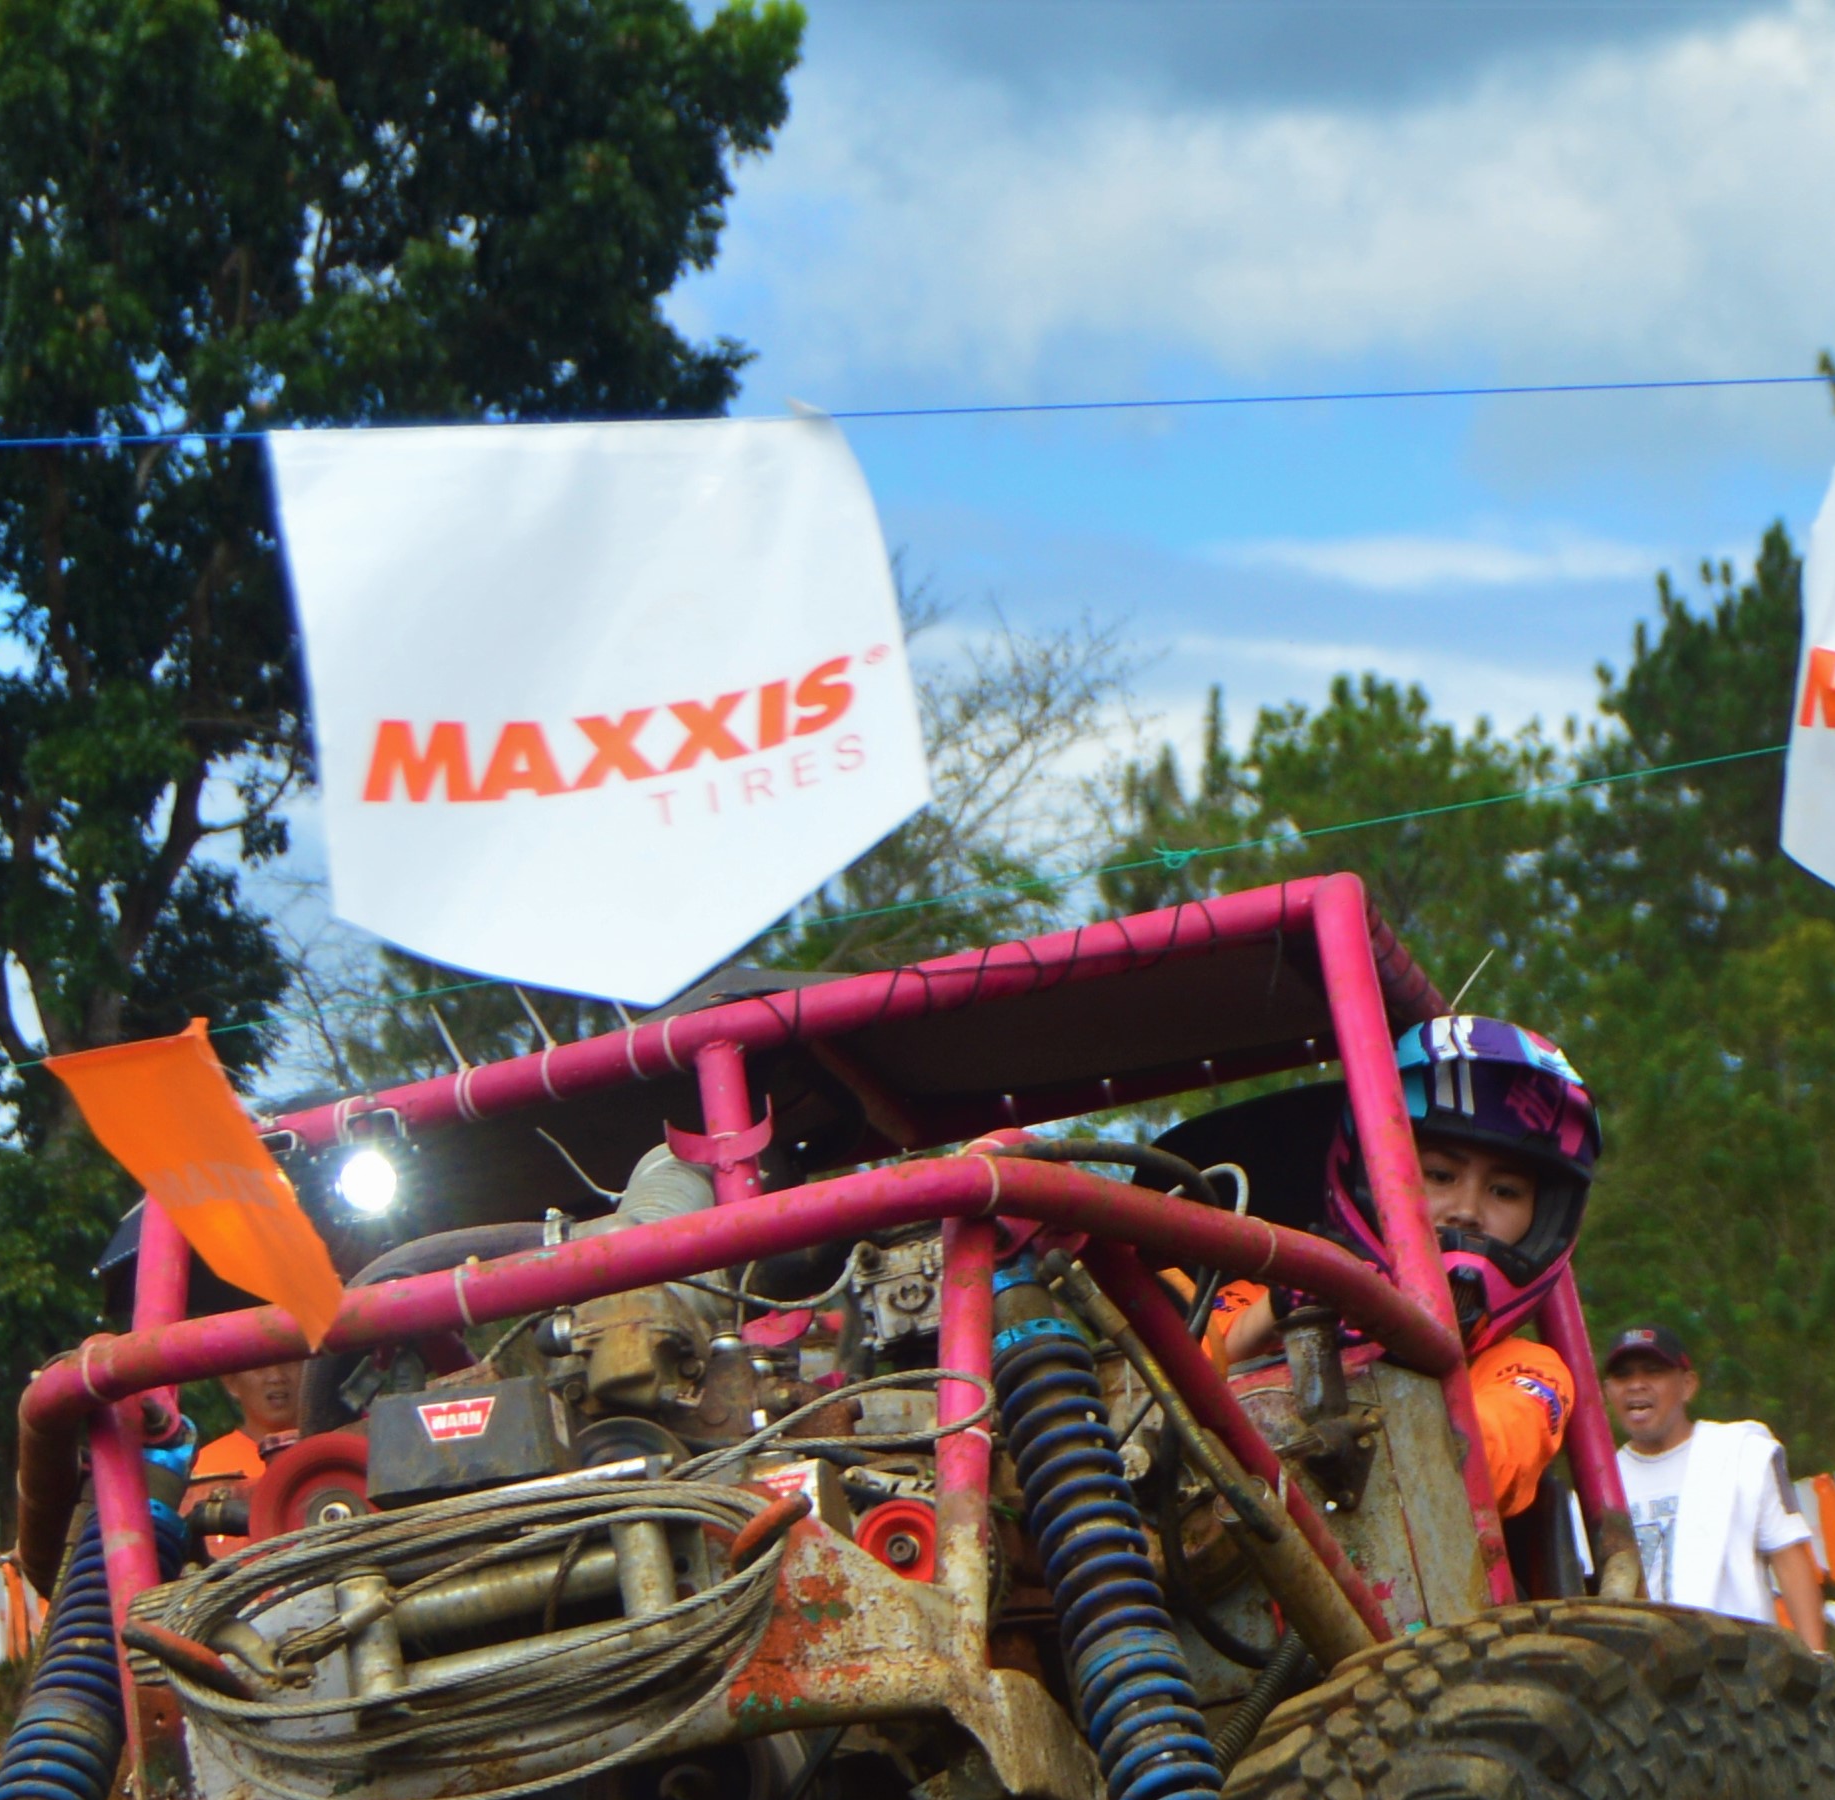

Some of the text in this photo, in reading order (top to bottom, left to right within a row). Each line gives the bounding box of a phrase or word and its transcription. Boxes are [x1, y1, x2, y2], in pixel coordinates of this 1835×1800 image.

[361, 655, 856, 803] MAXXIS
[649, 734, 866, 827] TIRES
[431, 1409, 483, 1431] WARN
